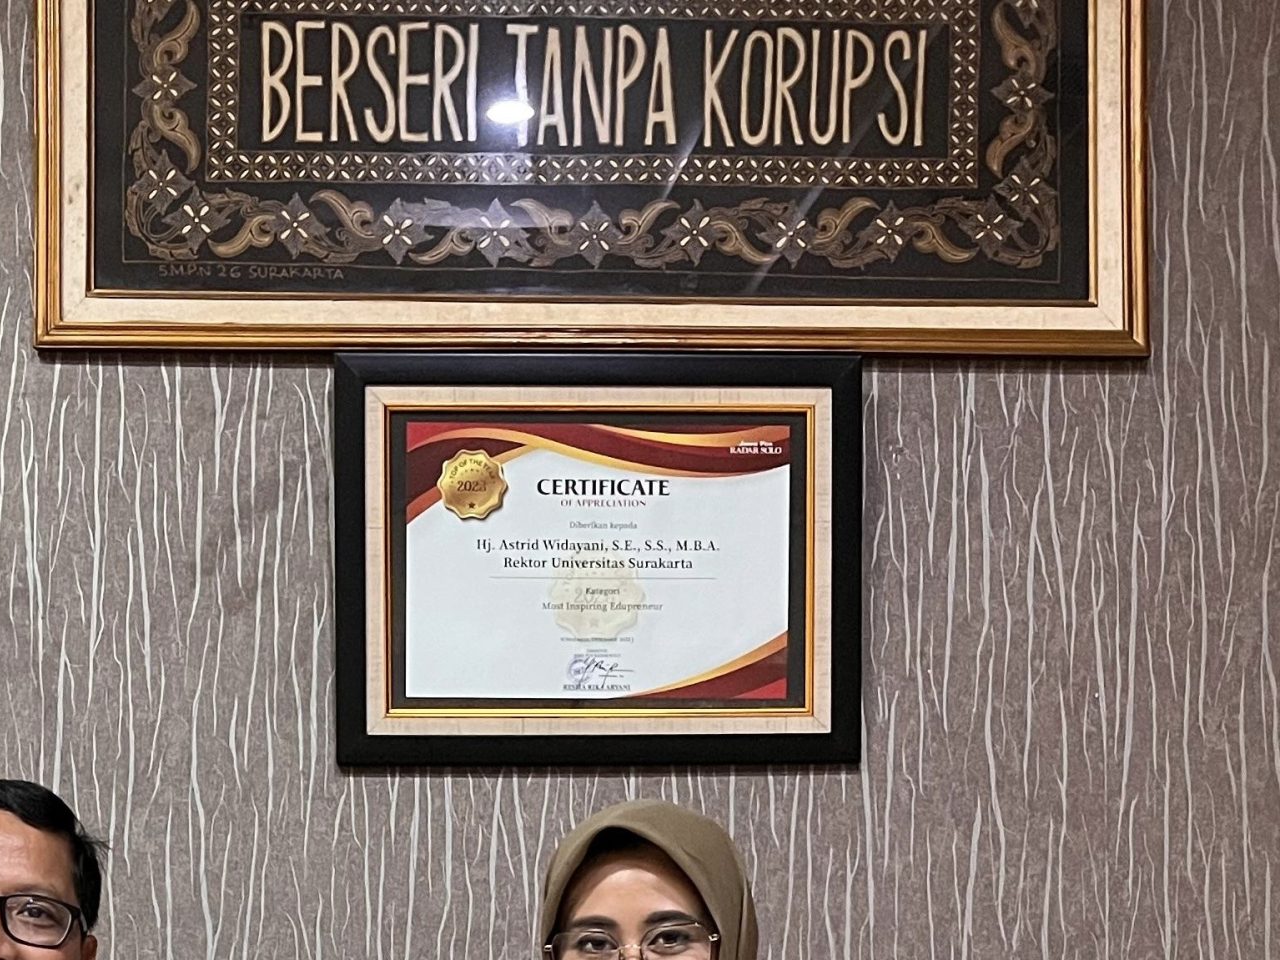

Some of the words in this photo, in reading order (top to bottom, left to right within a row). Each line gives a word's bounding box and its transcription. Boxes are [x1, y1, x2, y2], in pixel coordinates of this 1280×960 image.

[261, 20, 479, 142] BERSERI
[506, 23, 677, 147] TANPA
[703, 26, 927, 147] KORUPSI
[217, 264, 241, 279] 26
[249, 265, 344, 280] SURAKARTA
[536, 478, 671, 496] CERTIFICATE
[560, 499, 572, 507] OF
[576, 499, 647, 508] APPRECIATION
[569, 521, 608, 530] Diberikan
[476, 540, 495, 553] Hj.
[499, 540, 539, 551] Astrid
[543, 540, 609, 554] Widayani,
[612, 540, 641, 553] S.E.,
[644, 541, 672, 553] S.S.,
[676, 541, 720, 551] M.B.A.
[503, 557, 548, 569] Rektor
[552, 557, 625, 569] Universitas
[628, 558, 693, 569] Surakarta
[585, 587, 620, 597] Kategori
[542, 602, 564, 611] Most
[566, 602, 608, 613] Inspiring
[610, 602, 663, 613] Edupreneur
